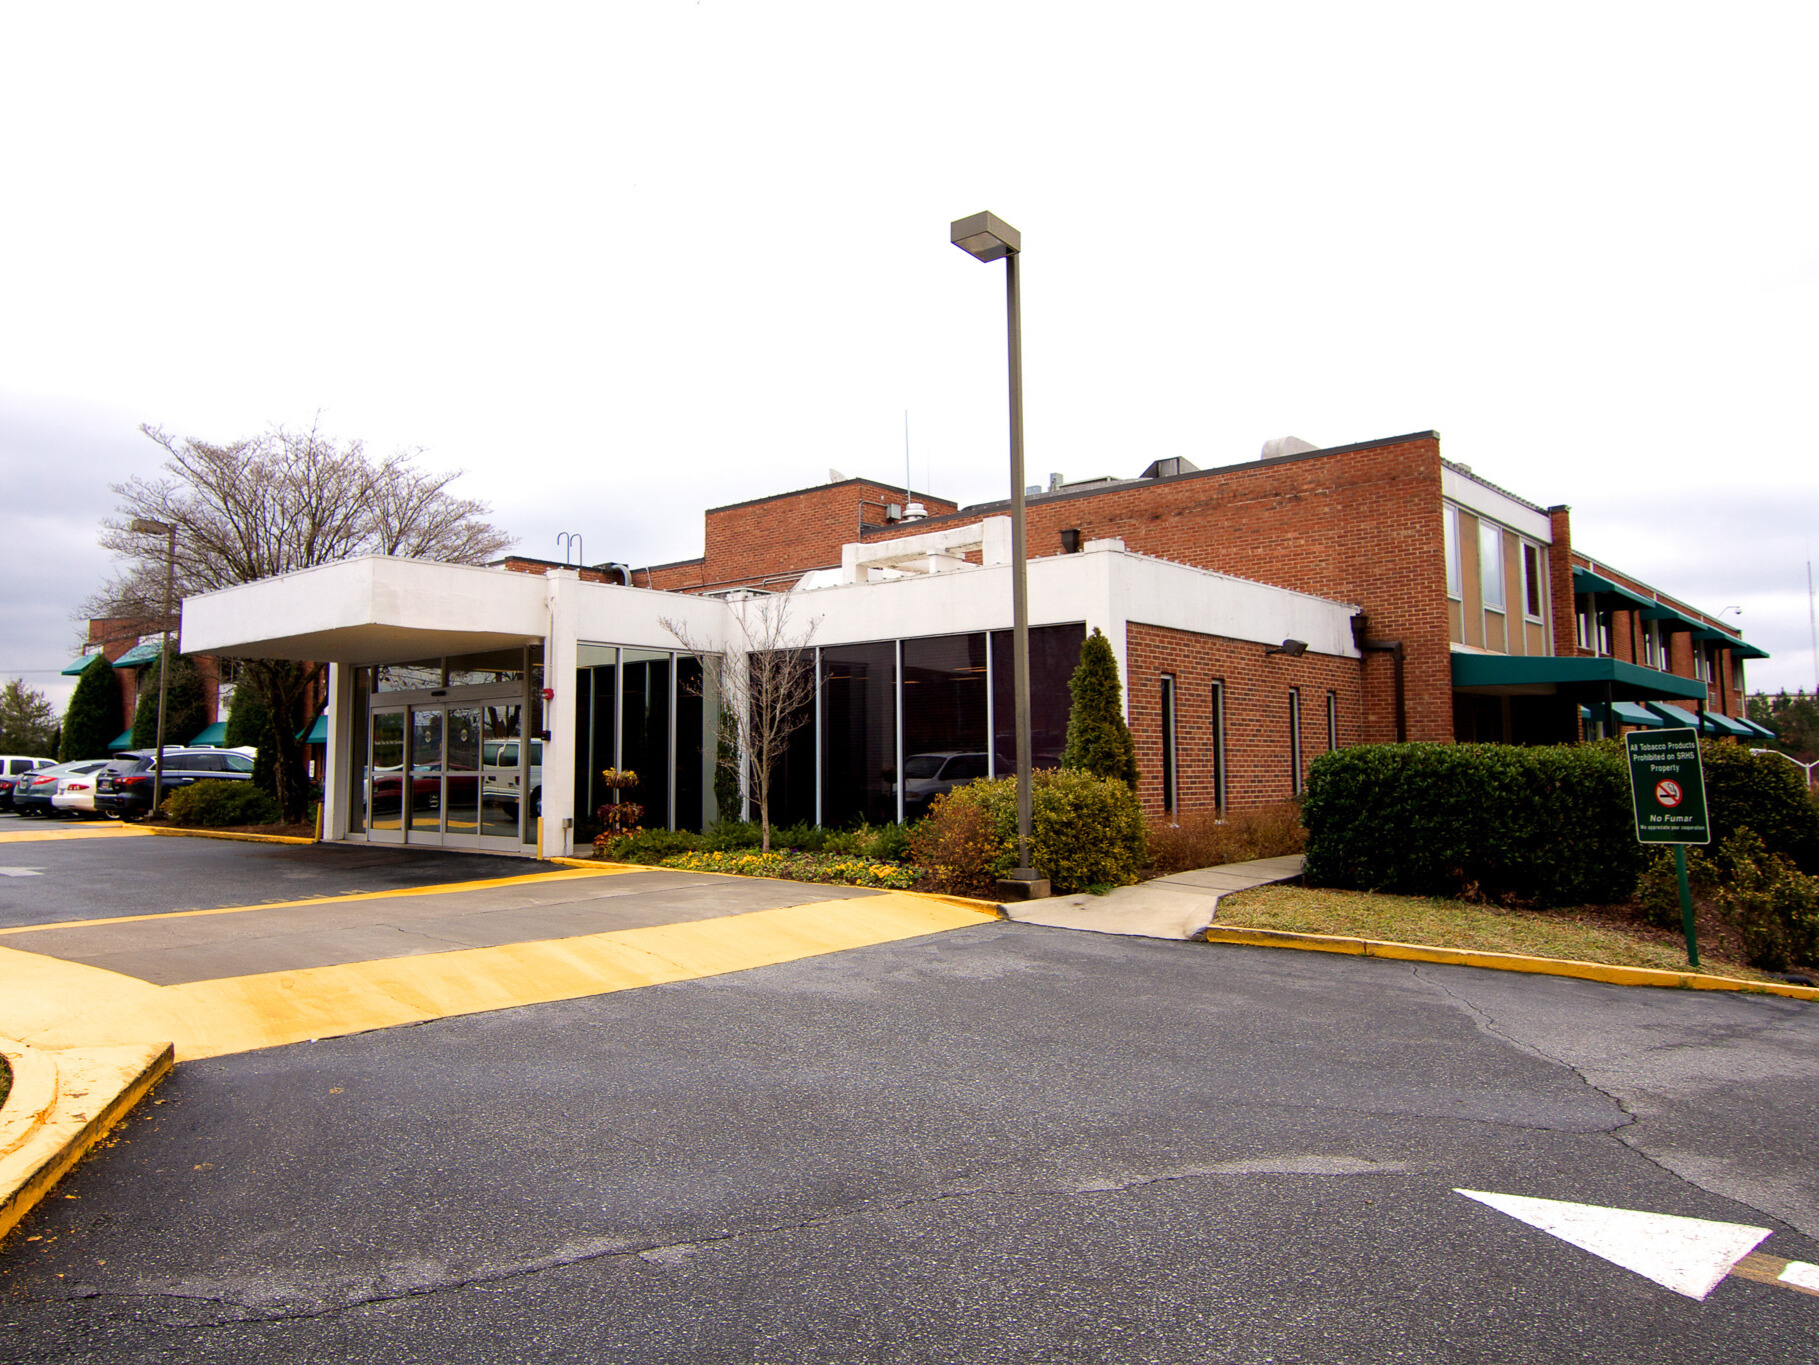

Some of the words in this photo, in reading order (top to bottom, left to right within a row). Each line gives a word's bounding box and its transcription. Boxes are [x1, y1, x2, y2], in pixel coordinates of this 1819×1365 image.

[1630, 743, 1639, 751] All
[1639, 743, 1667, 751] Tobacco
[1667, 741, 1696, 750] Products
[1632, 753, 1666, 761] Prohibited
[1676, 751, 1695, 760] SRHS
[1650, 764, 1680, 773] Property
[1649, 814, 1663, 822] No
[1664, 814, 1693, 822] Fumar
